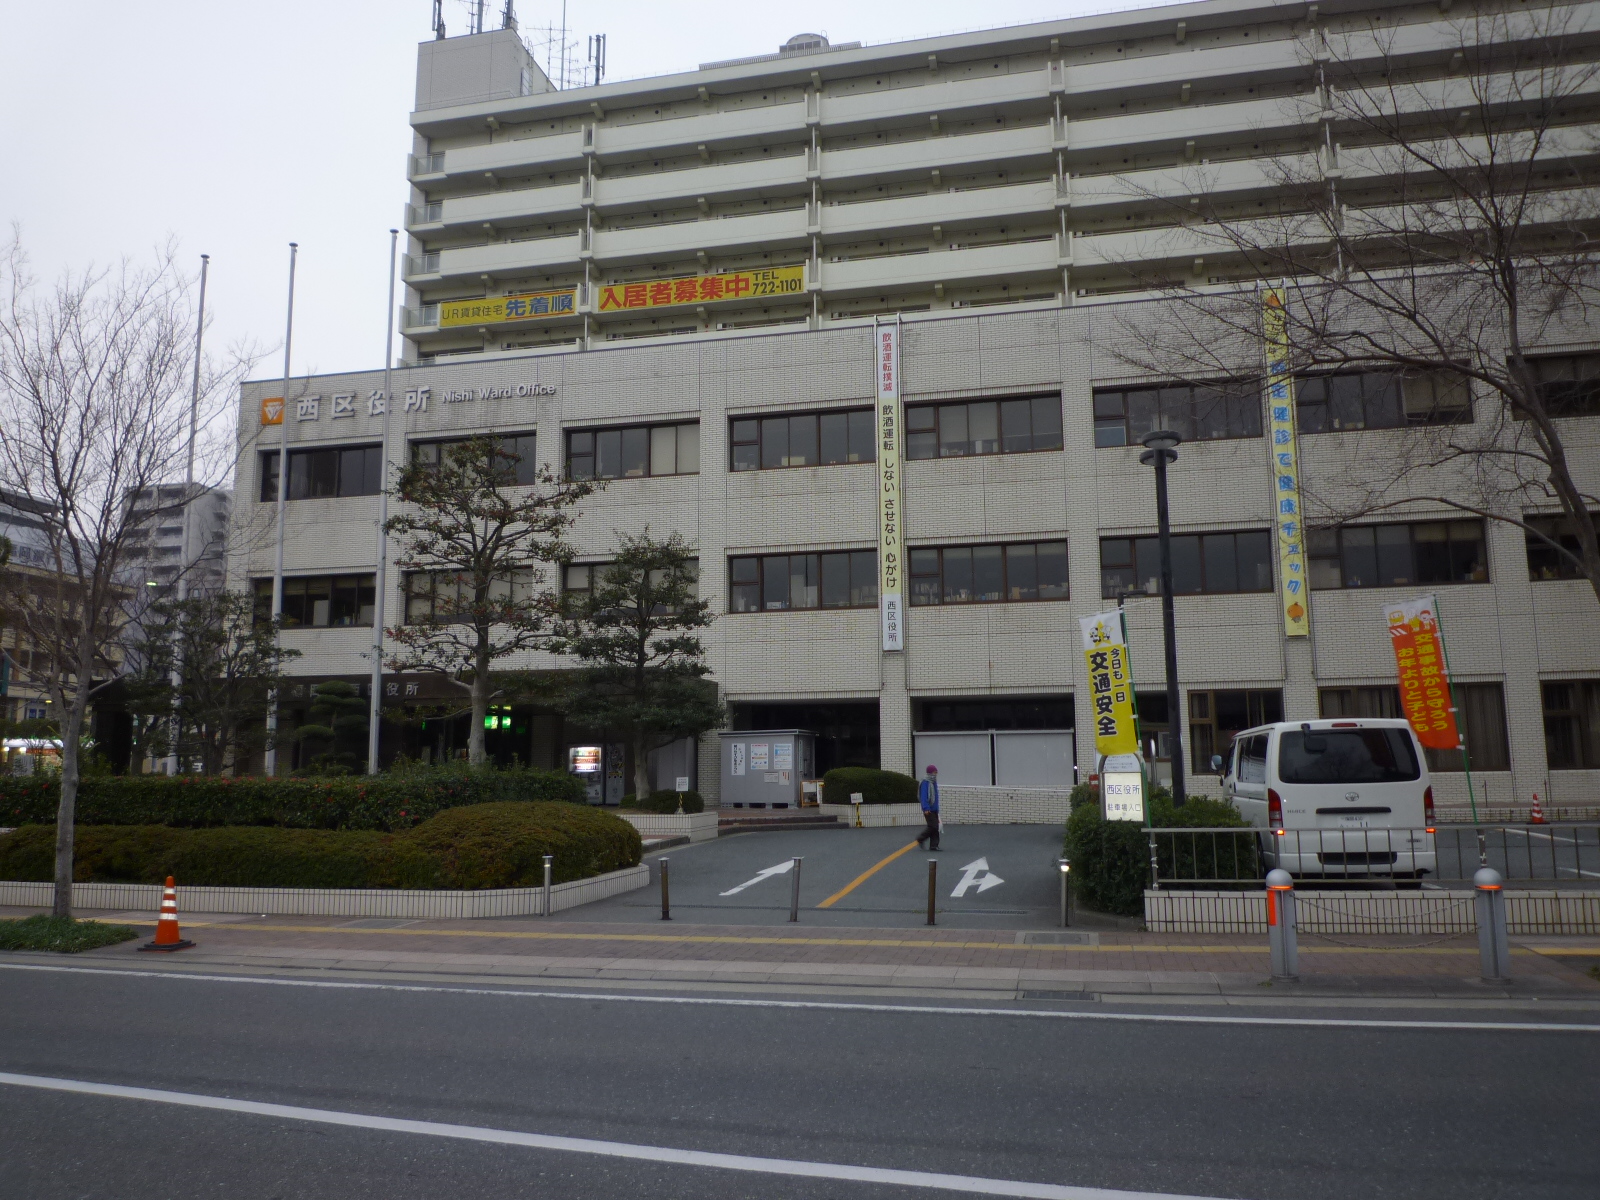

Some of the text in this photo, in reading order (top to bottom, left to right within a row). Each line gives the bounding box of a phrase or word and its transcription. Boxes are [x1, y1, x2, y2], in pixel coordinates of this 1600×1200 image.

[600, 274, 750, 310] 入居者募集中
[752, 271, 780, 282] TEL
[752, 278, 802, 295] 722-1101
[505, 294, 573, 317] 先着順
[882, 332, 893, 392] 飲酒運転撲滅
[296, 385, 430, 422] 西区役所
[442, 383, 557, 404] Nishi Ward Office
[882, 404, 897, 588] 飲酒運転 しない させない 心がけ
[887, 600, 897, 642] 西区役所
[1089, 651, 1118, 737] 交通安全
[1110, 648, 1125, 703] 今日も一日
[1397, 647, 1430, 732] お年よりと子ども
[1414, 633, 1448, 731] 交通事故から守ろう
[1106, 784, 1140, 795] 西区役所
[1107, 803, 1141, 812] 駐車場入口
